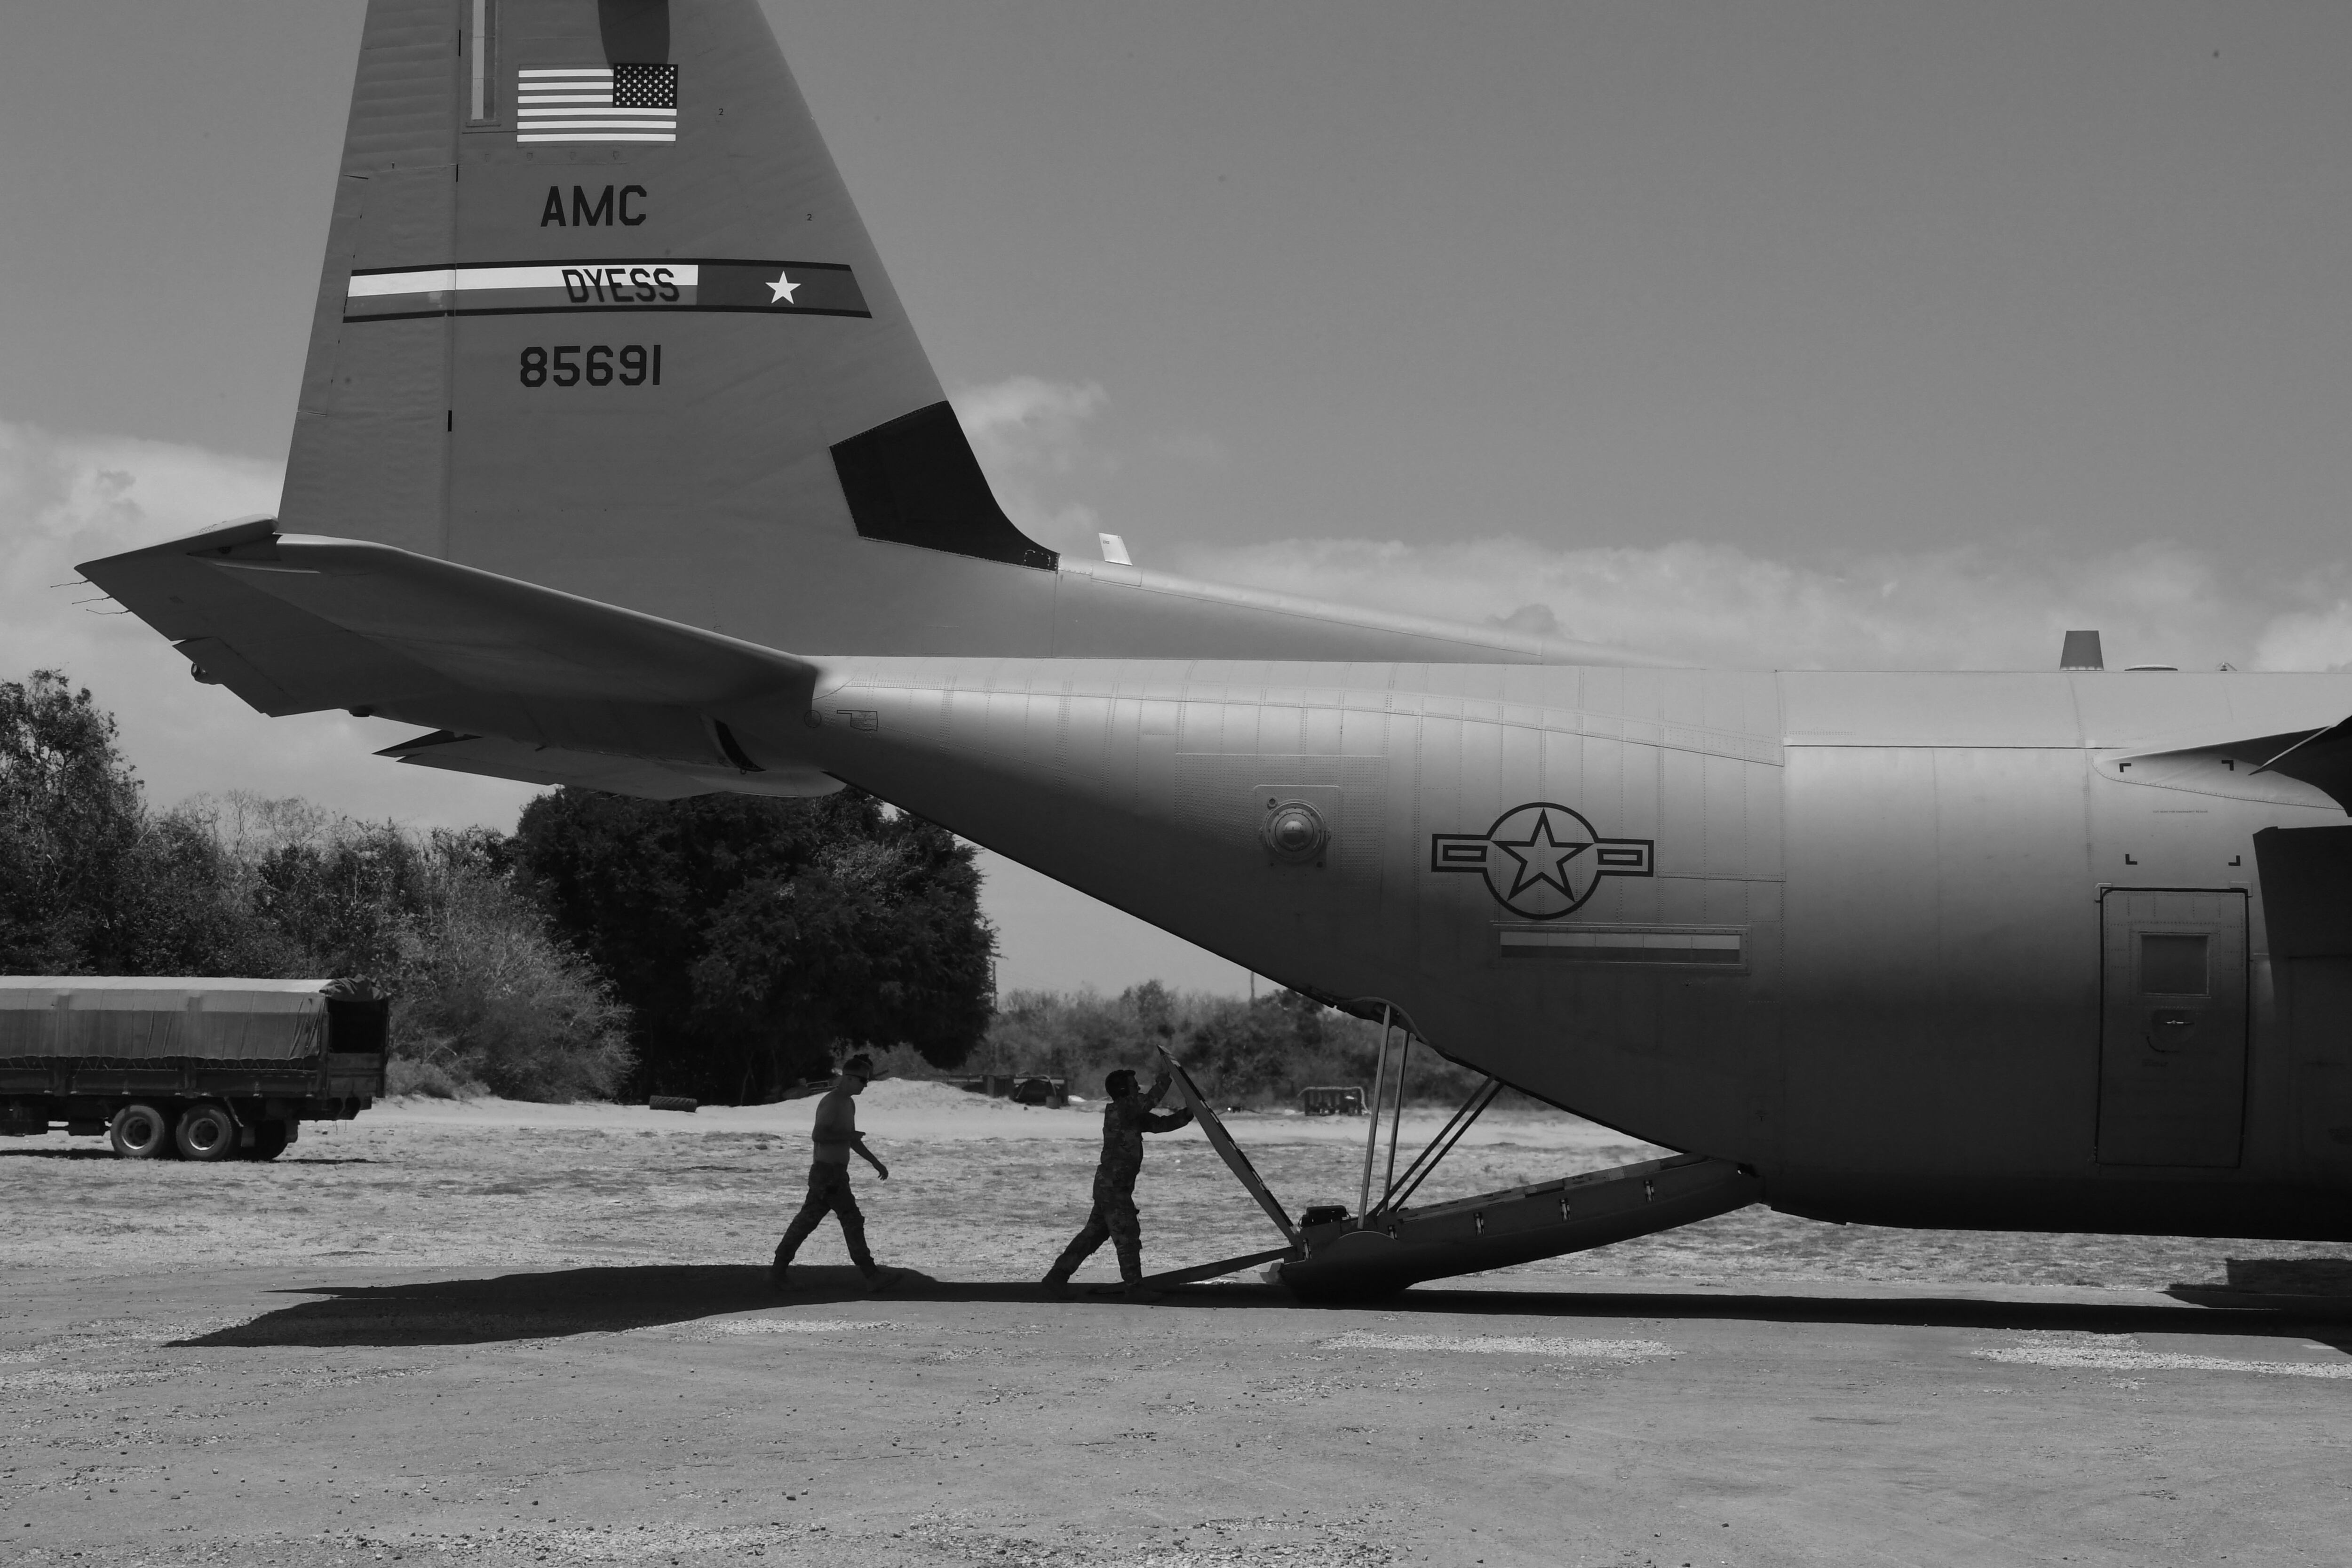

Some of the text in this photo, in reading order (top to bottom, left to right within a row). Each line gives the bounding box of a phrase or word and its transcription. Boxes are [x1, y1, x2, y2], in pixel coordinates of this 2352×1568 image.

[540, 185, 647, 227] AMC
[561, 268, 680, 303] DYESS
[520, 344, 661, 388] 85691
